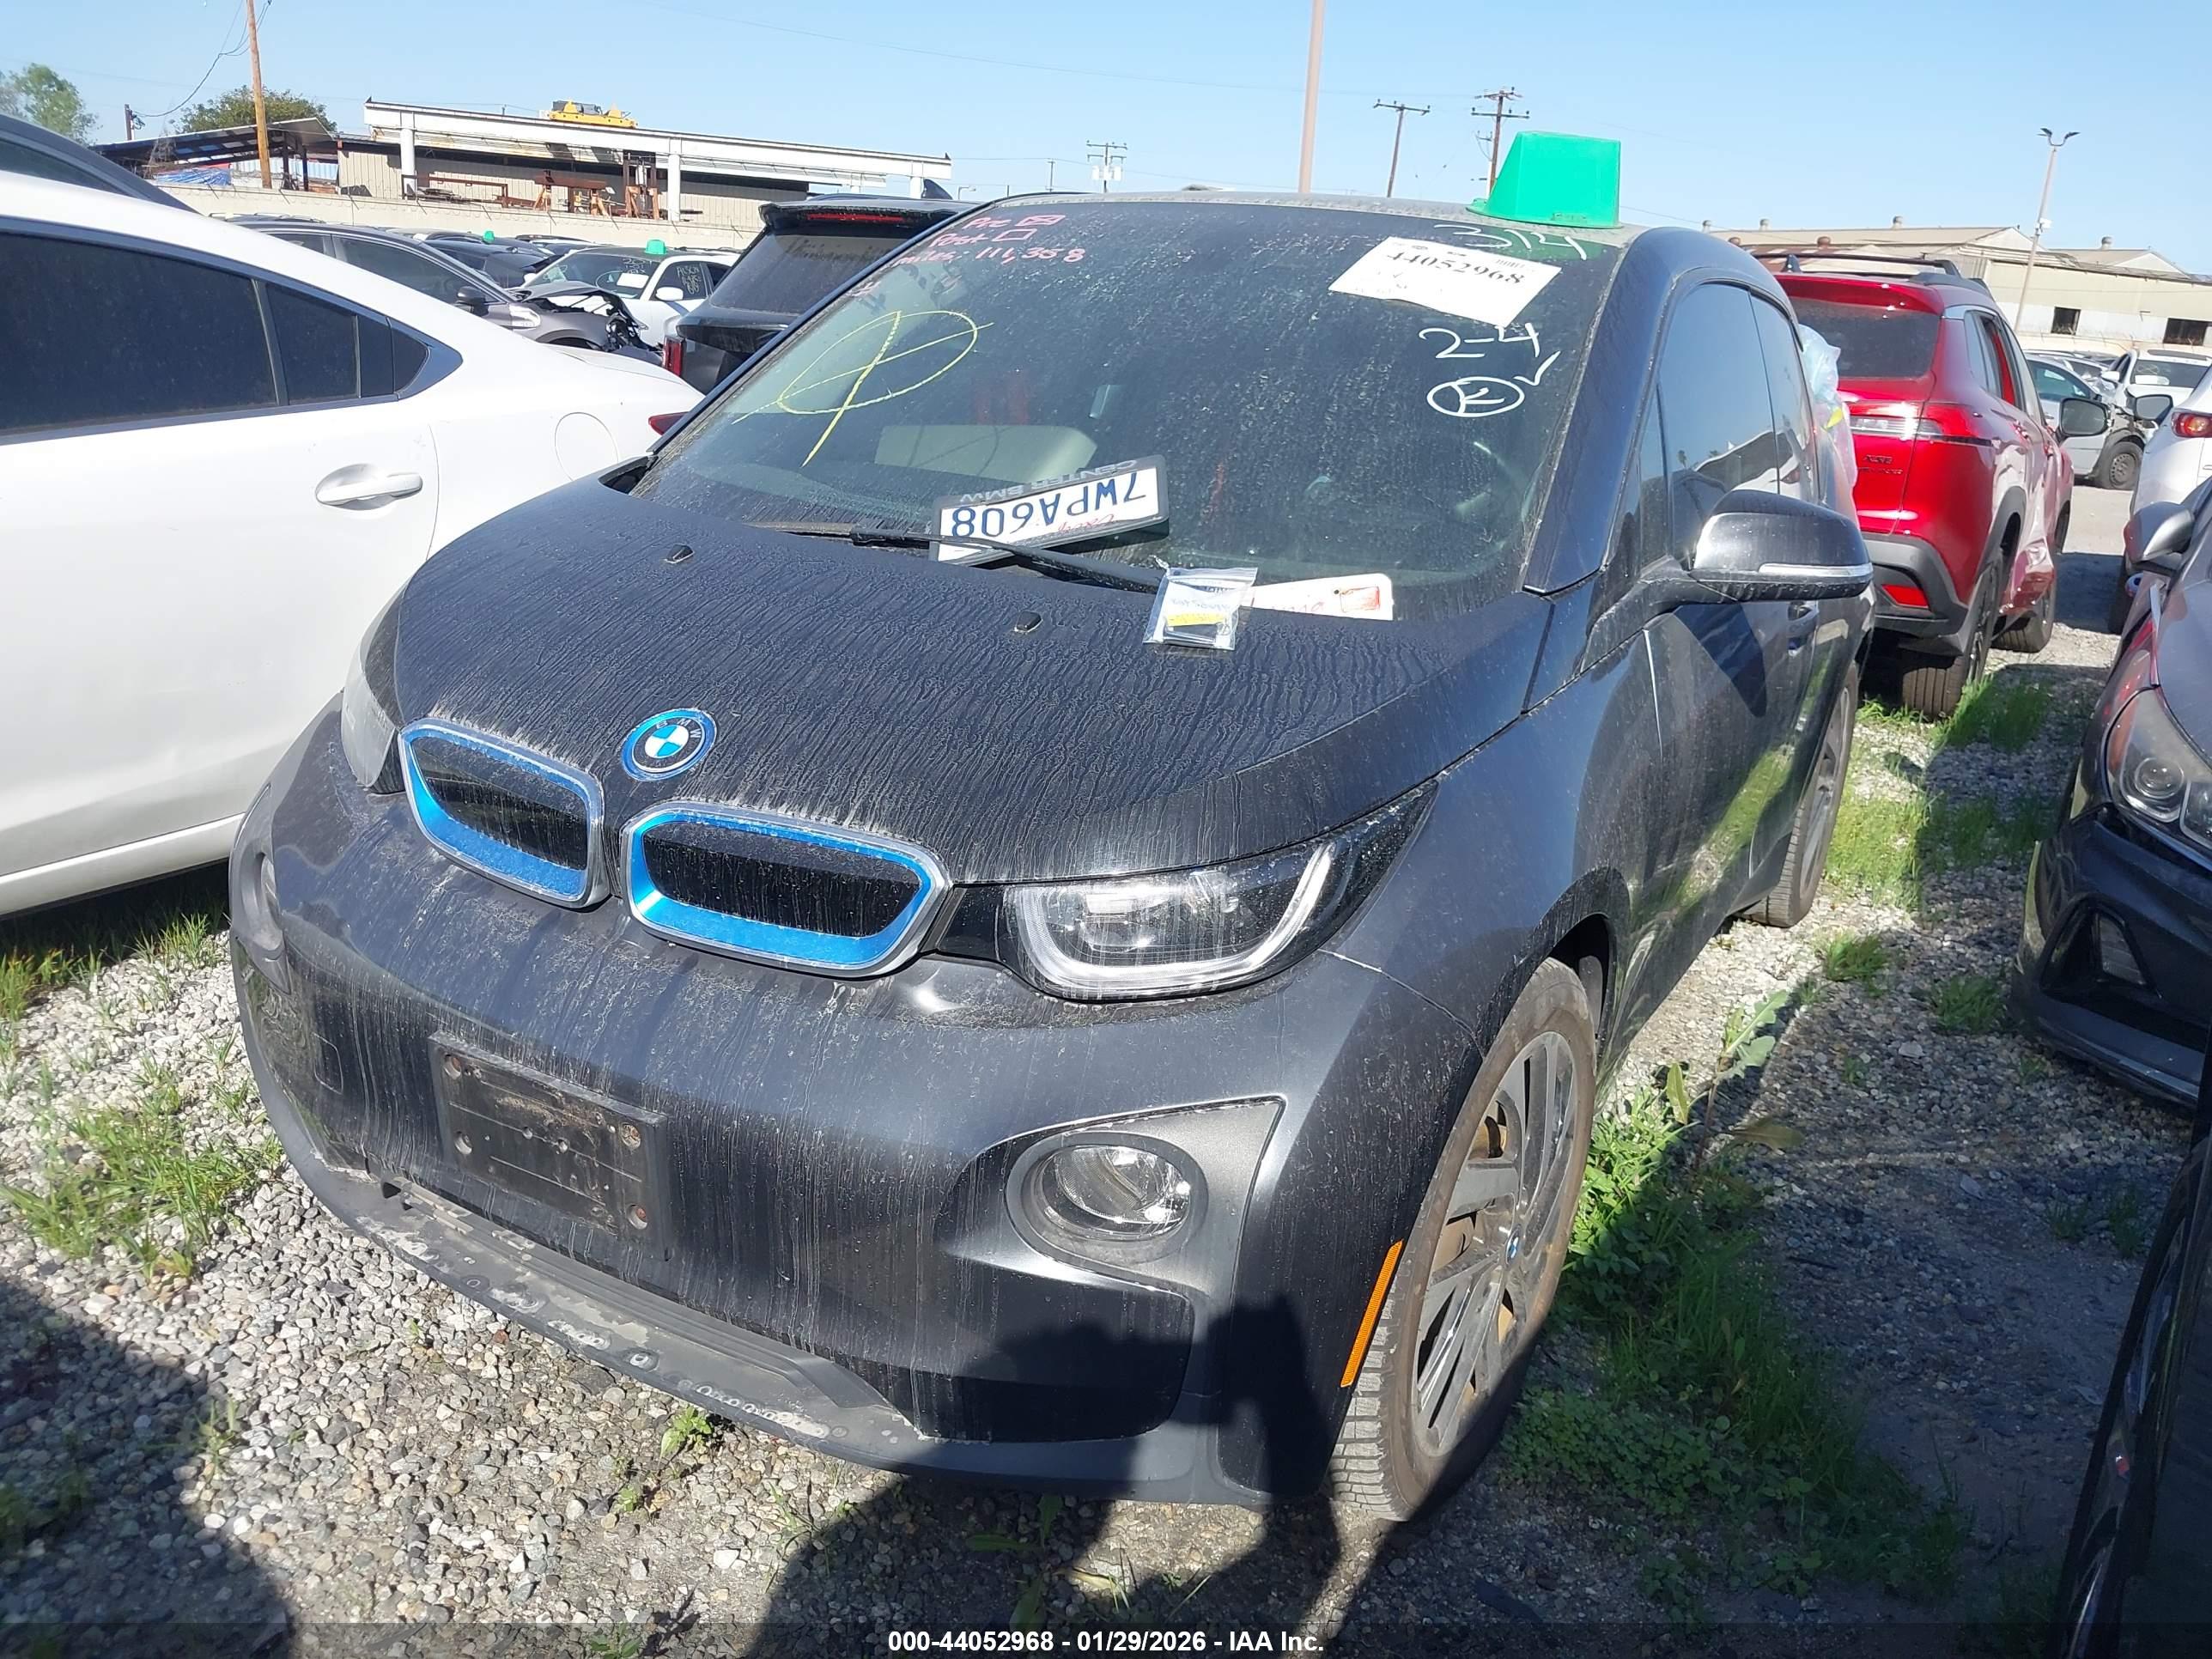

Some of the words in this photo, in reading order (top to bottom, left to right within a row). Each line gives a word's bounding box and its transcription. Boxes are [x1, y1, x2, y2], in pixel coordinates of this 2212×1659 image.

[1031, 459, 1138, 489] CENTER
[951, 472, 1147, 538] 7WPA608
[959, 484, 1024, 502] BMW
[655, 717, 702, 739] BMW
